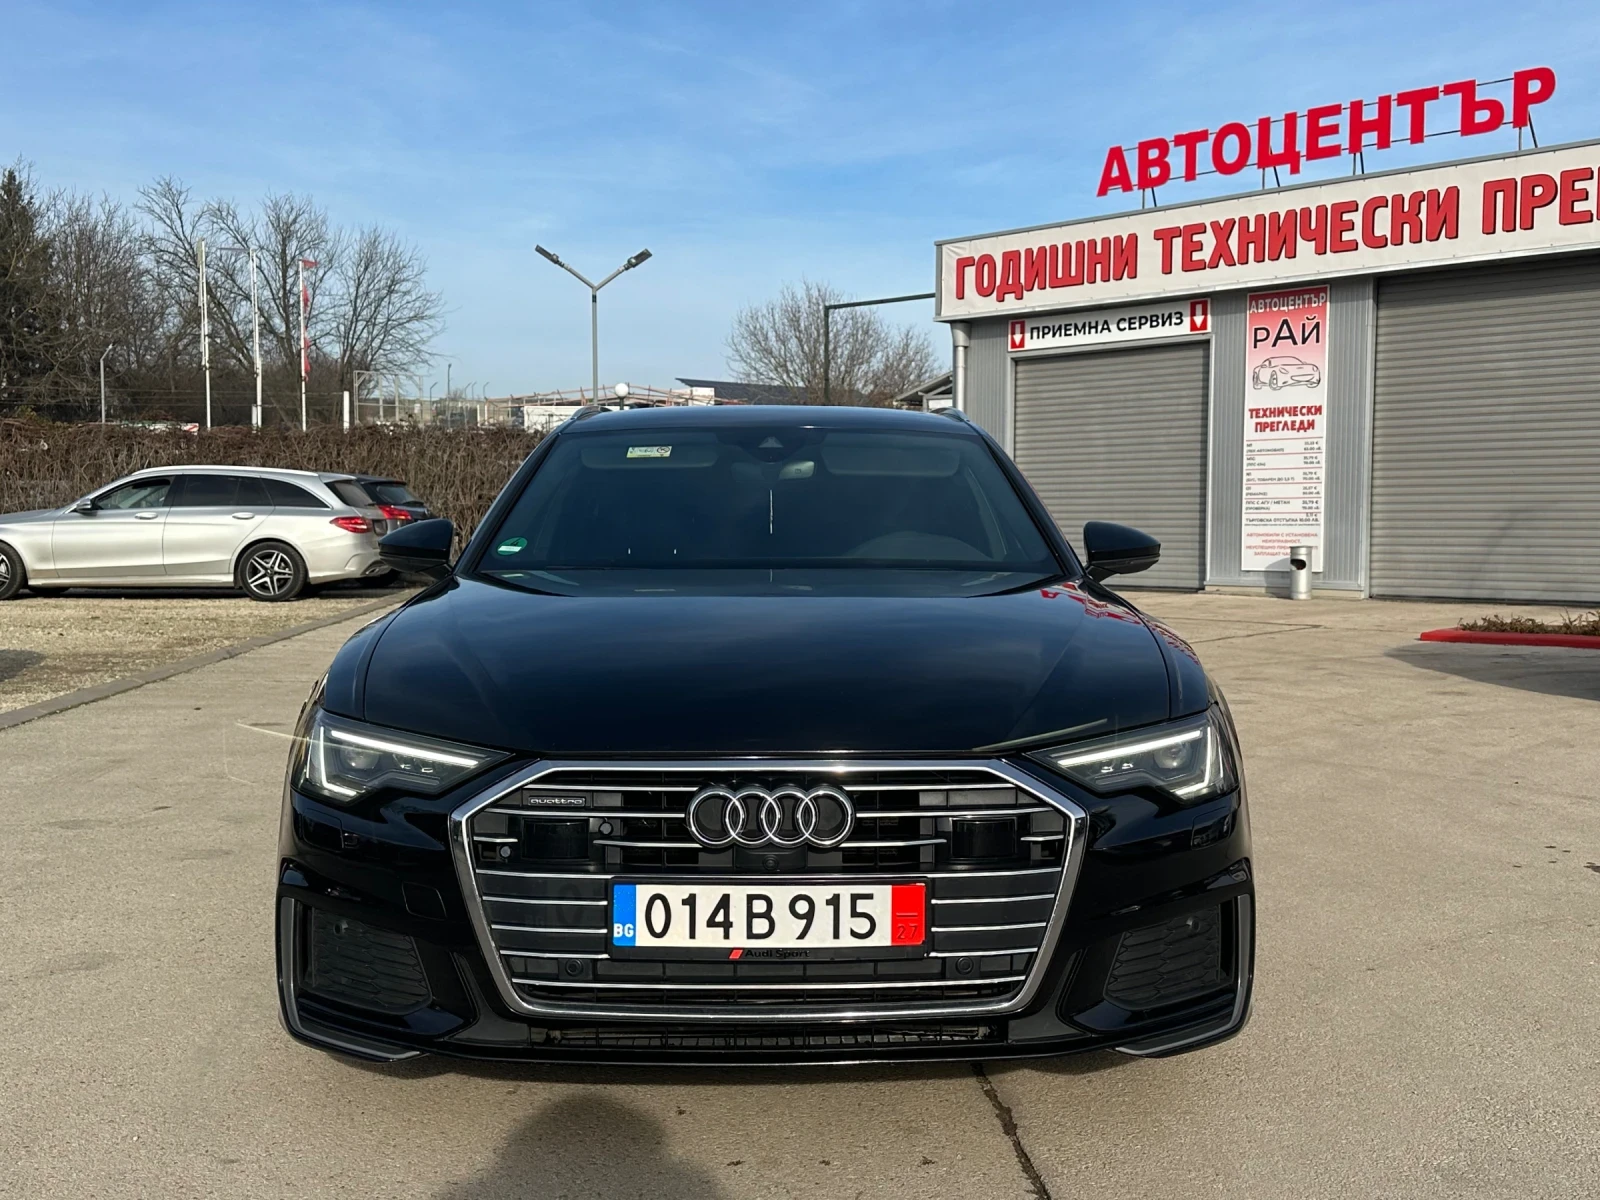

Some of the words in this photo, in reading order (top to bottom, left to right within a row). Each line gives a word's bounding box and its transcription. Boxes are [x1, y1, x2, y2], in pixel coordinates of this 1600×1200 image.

[1097, 67, 1556, 197] АВТОЦЕНТЪР
[956, 233, 1138, 302] ГОДИШНИ
[1153, 186, 1459, 274] ТЕХНИЧЕСКИ
[1482, 166, 1600, 235] ПРЕ
[1249, 293, 1326, 314] АВТОЦЕНТЪР
[1030, 320, 1111, 340] ПРИЕМНА
[1116, 311, 1184, 332] СЕРВИЗ
[1248, 405, 1323, 419] ТЕХНИЧЕСКИ
[1254, 419, 1315, 433] ПРЕГЛЕДИ
[530, 797, 583, 805] quattro
[613, 923, 635, 937] BG
[744, 949, 773, 958] Audi
[775, 949, 810, 959] Sport
